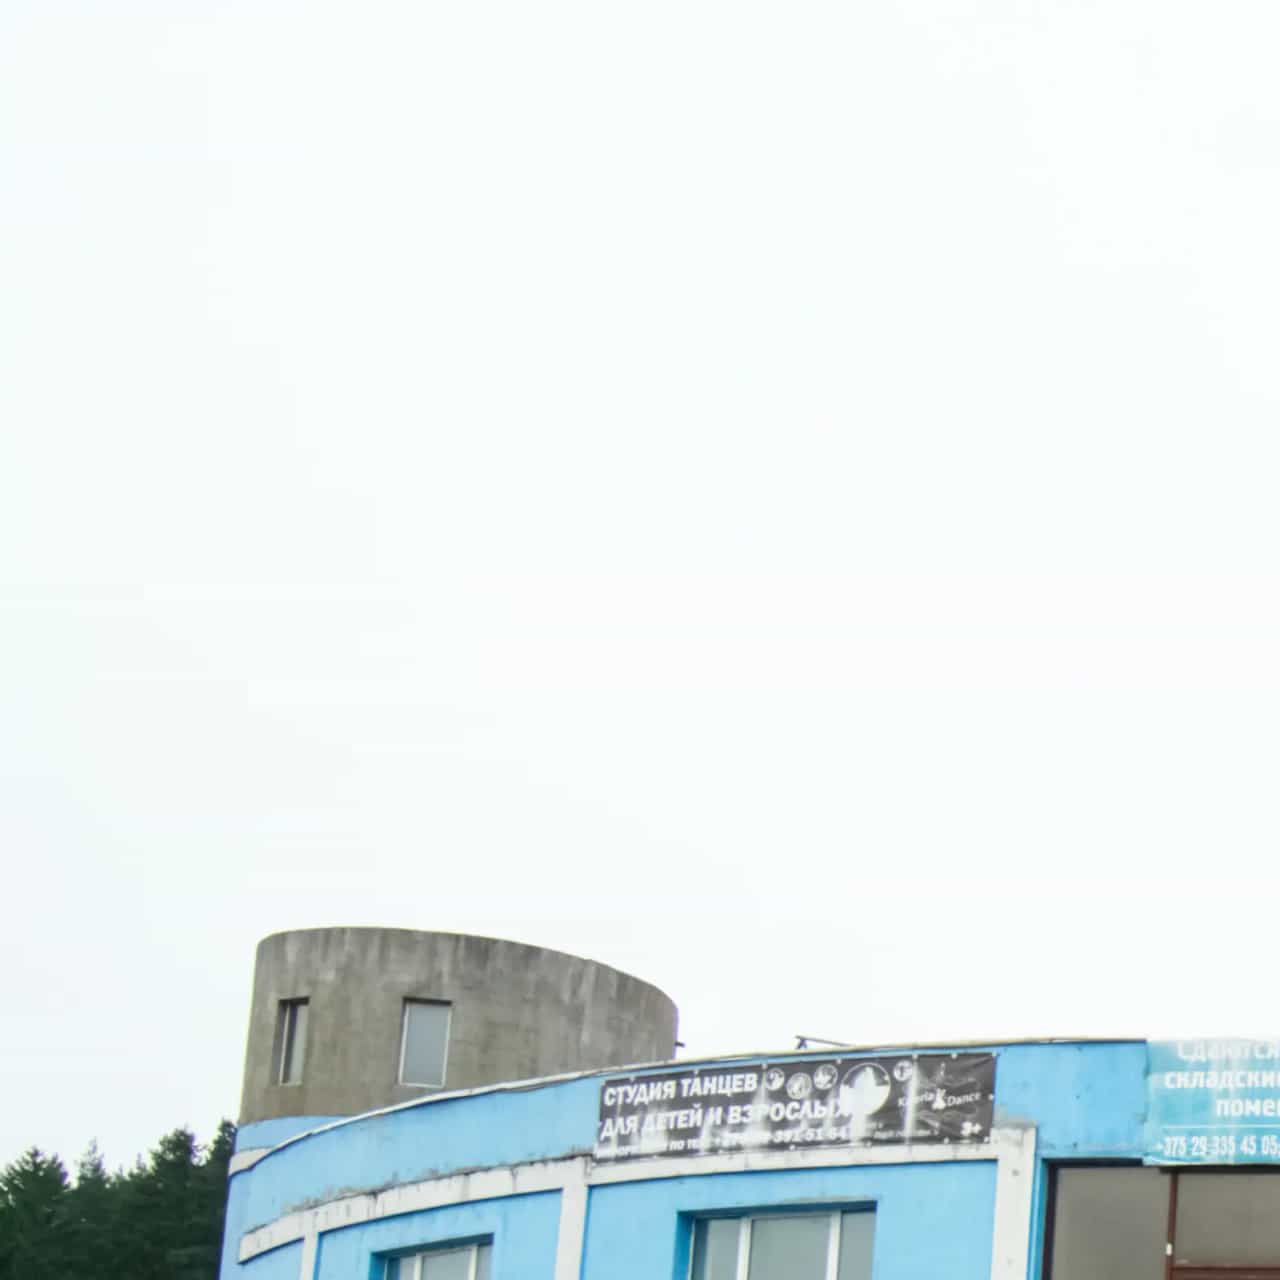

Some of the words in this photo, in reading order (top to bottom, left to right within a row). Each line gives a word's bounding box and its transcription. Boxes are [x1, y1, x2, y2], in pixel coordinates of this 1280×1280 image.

[604, 1083, 677, 1107] СТУДИЯ
[680, 1072, 759, 1098] ТАНЦЕВ
[600, 1115, 638, 1140] ДЛЯ
[641, 1104, 703, 1131] ДЕТЕЙ
[705, 1105, 724, 1126] И
